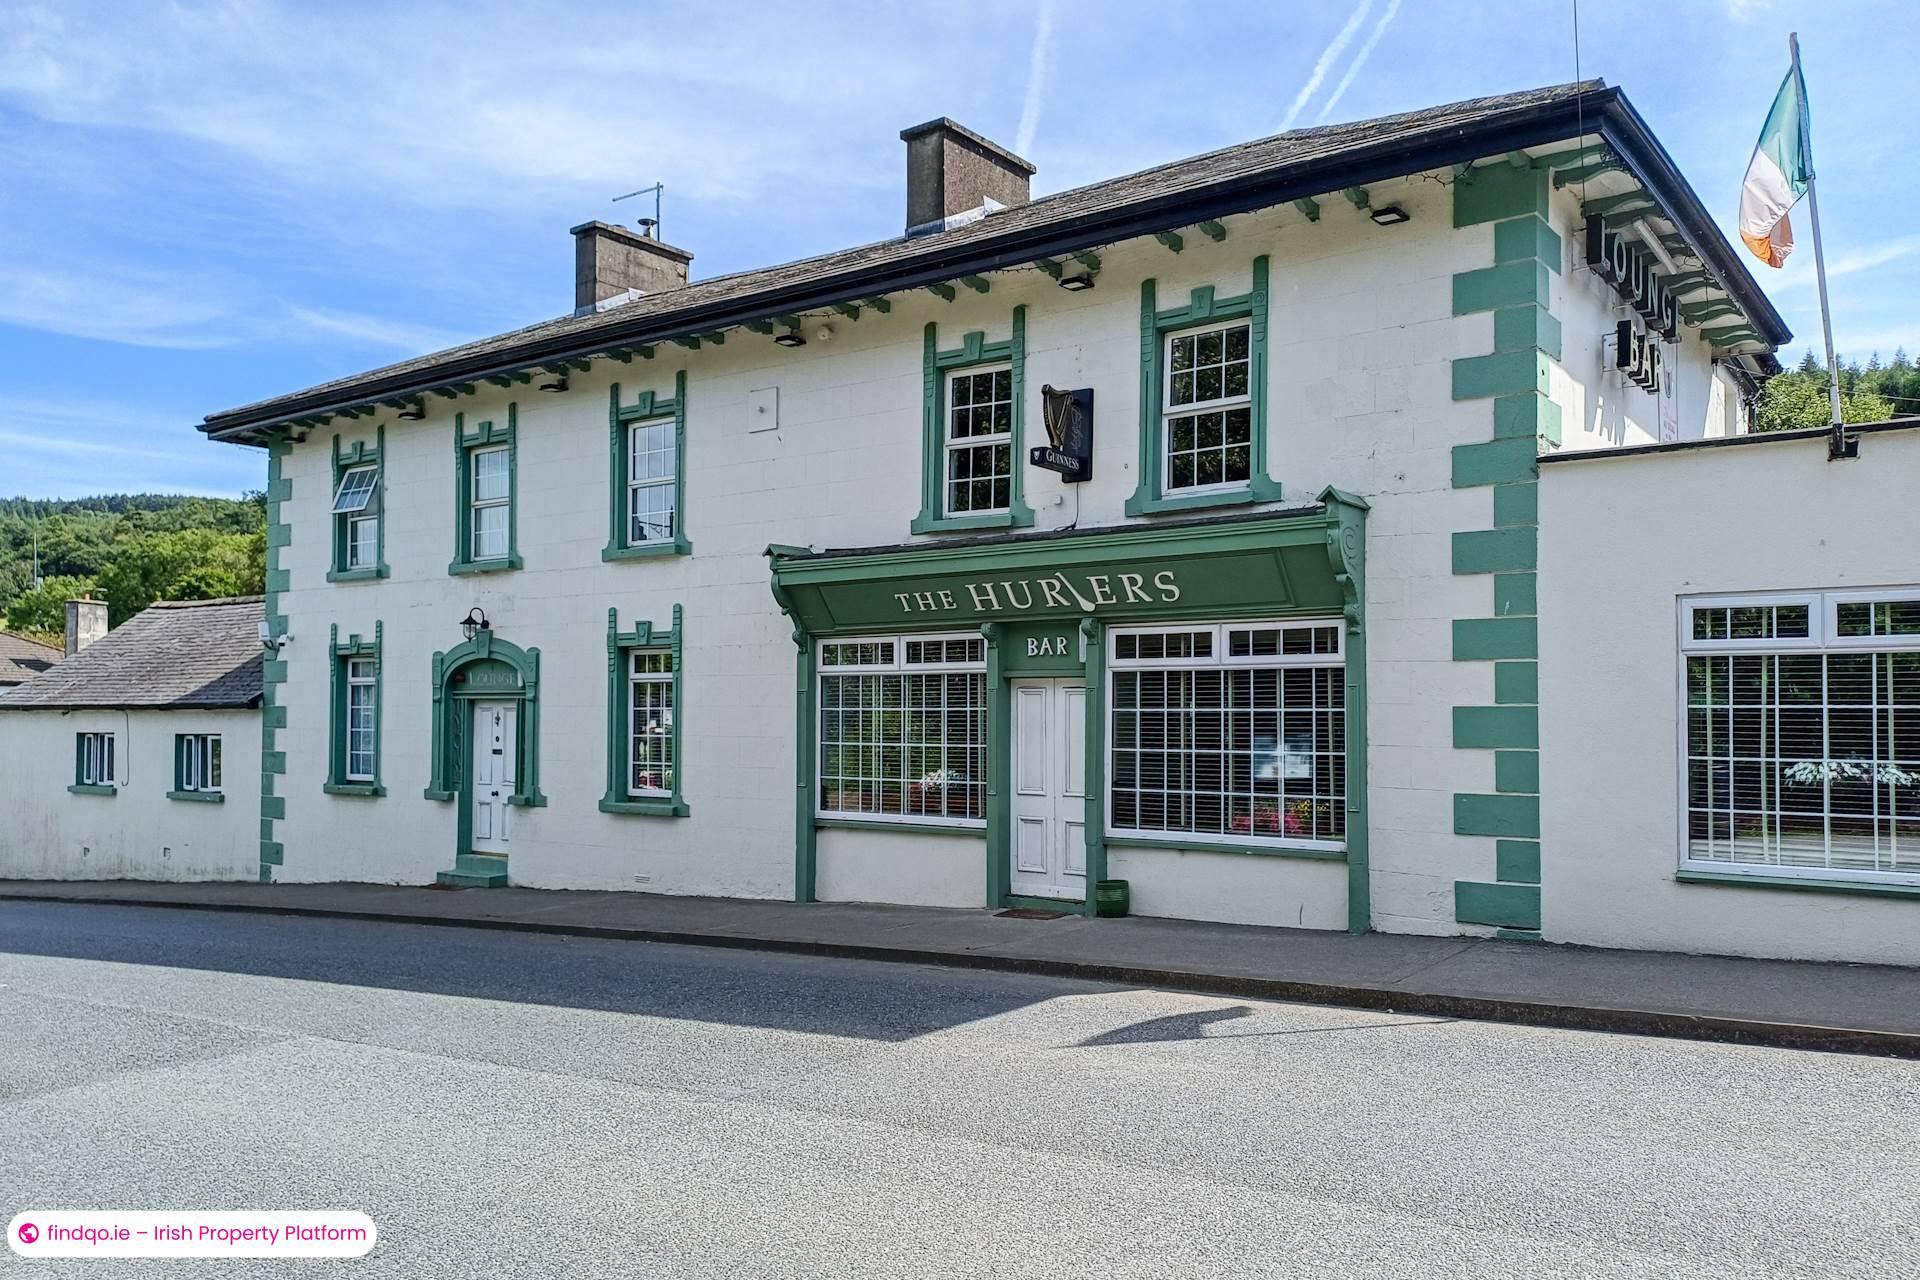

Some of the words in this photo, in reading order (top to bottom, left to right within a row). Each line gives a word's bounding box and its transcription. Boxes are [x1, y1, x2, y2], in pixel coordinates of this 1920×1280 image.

[1619, 320, 1664, 394] BAR
[1046, 449, 1080, 470] GUINNESS
[894, 590, 958, 612] THE
[965, 571, 1181, 612] HURLERS
[1026, 637, 1068, 657] BAR
